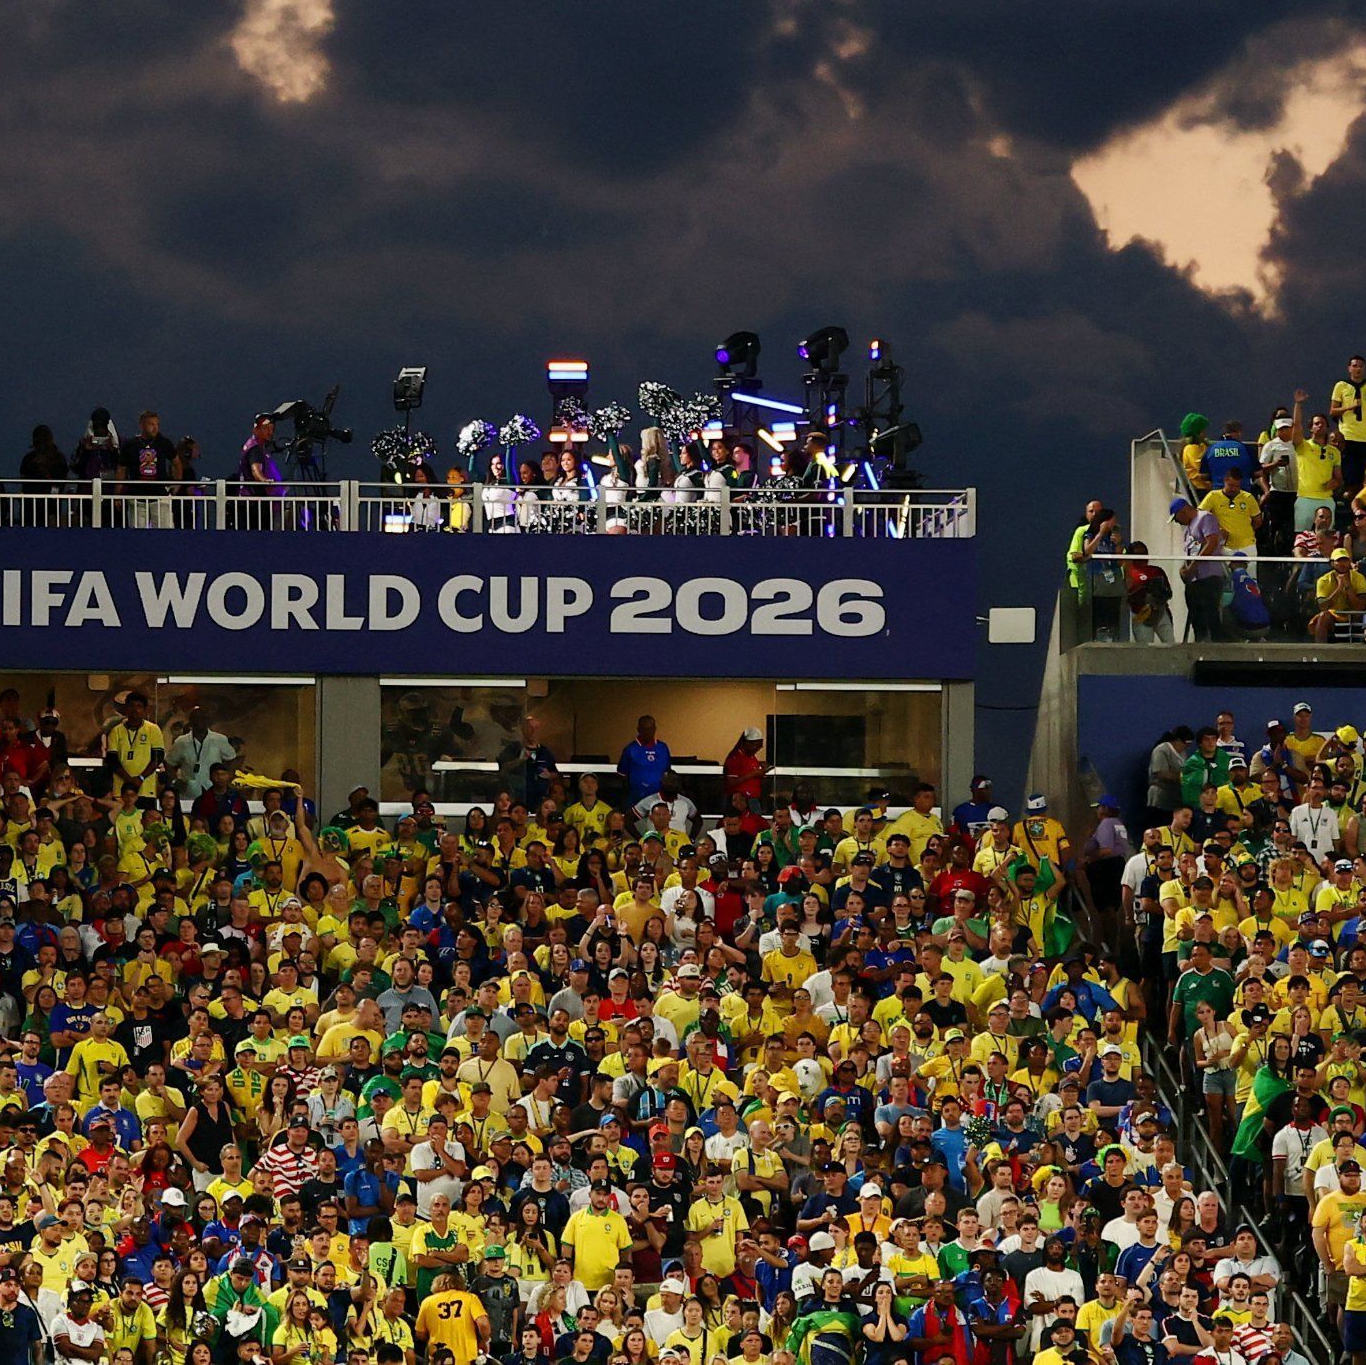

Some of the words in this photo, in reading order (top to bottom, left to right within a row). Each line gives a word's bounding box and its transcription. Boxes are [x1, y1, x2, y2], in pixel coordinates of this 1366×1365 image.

[1214, 447, 1241, 458] BRASIL
[134, 572, 421, 631] WORLD
[438, 575, 593, 633] CUP
[610, 576, 886, 637] 2026
[436, 1300, 463, 1321] 37
